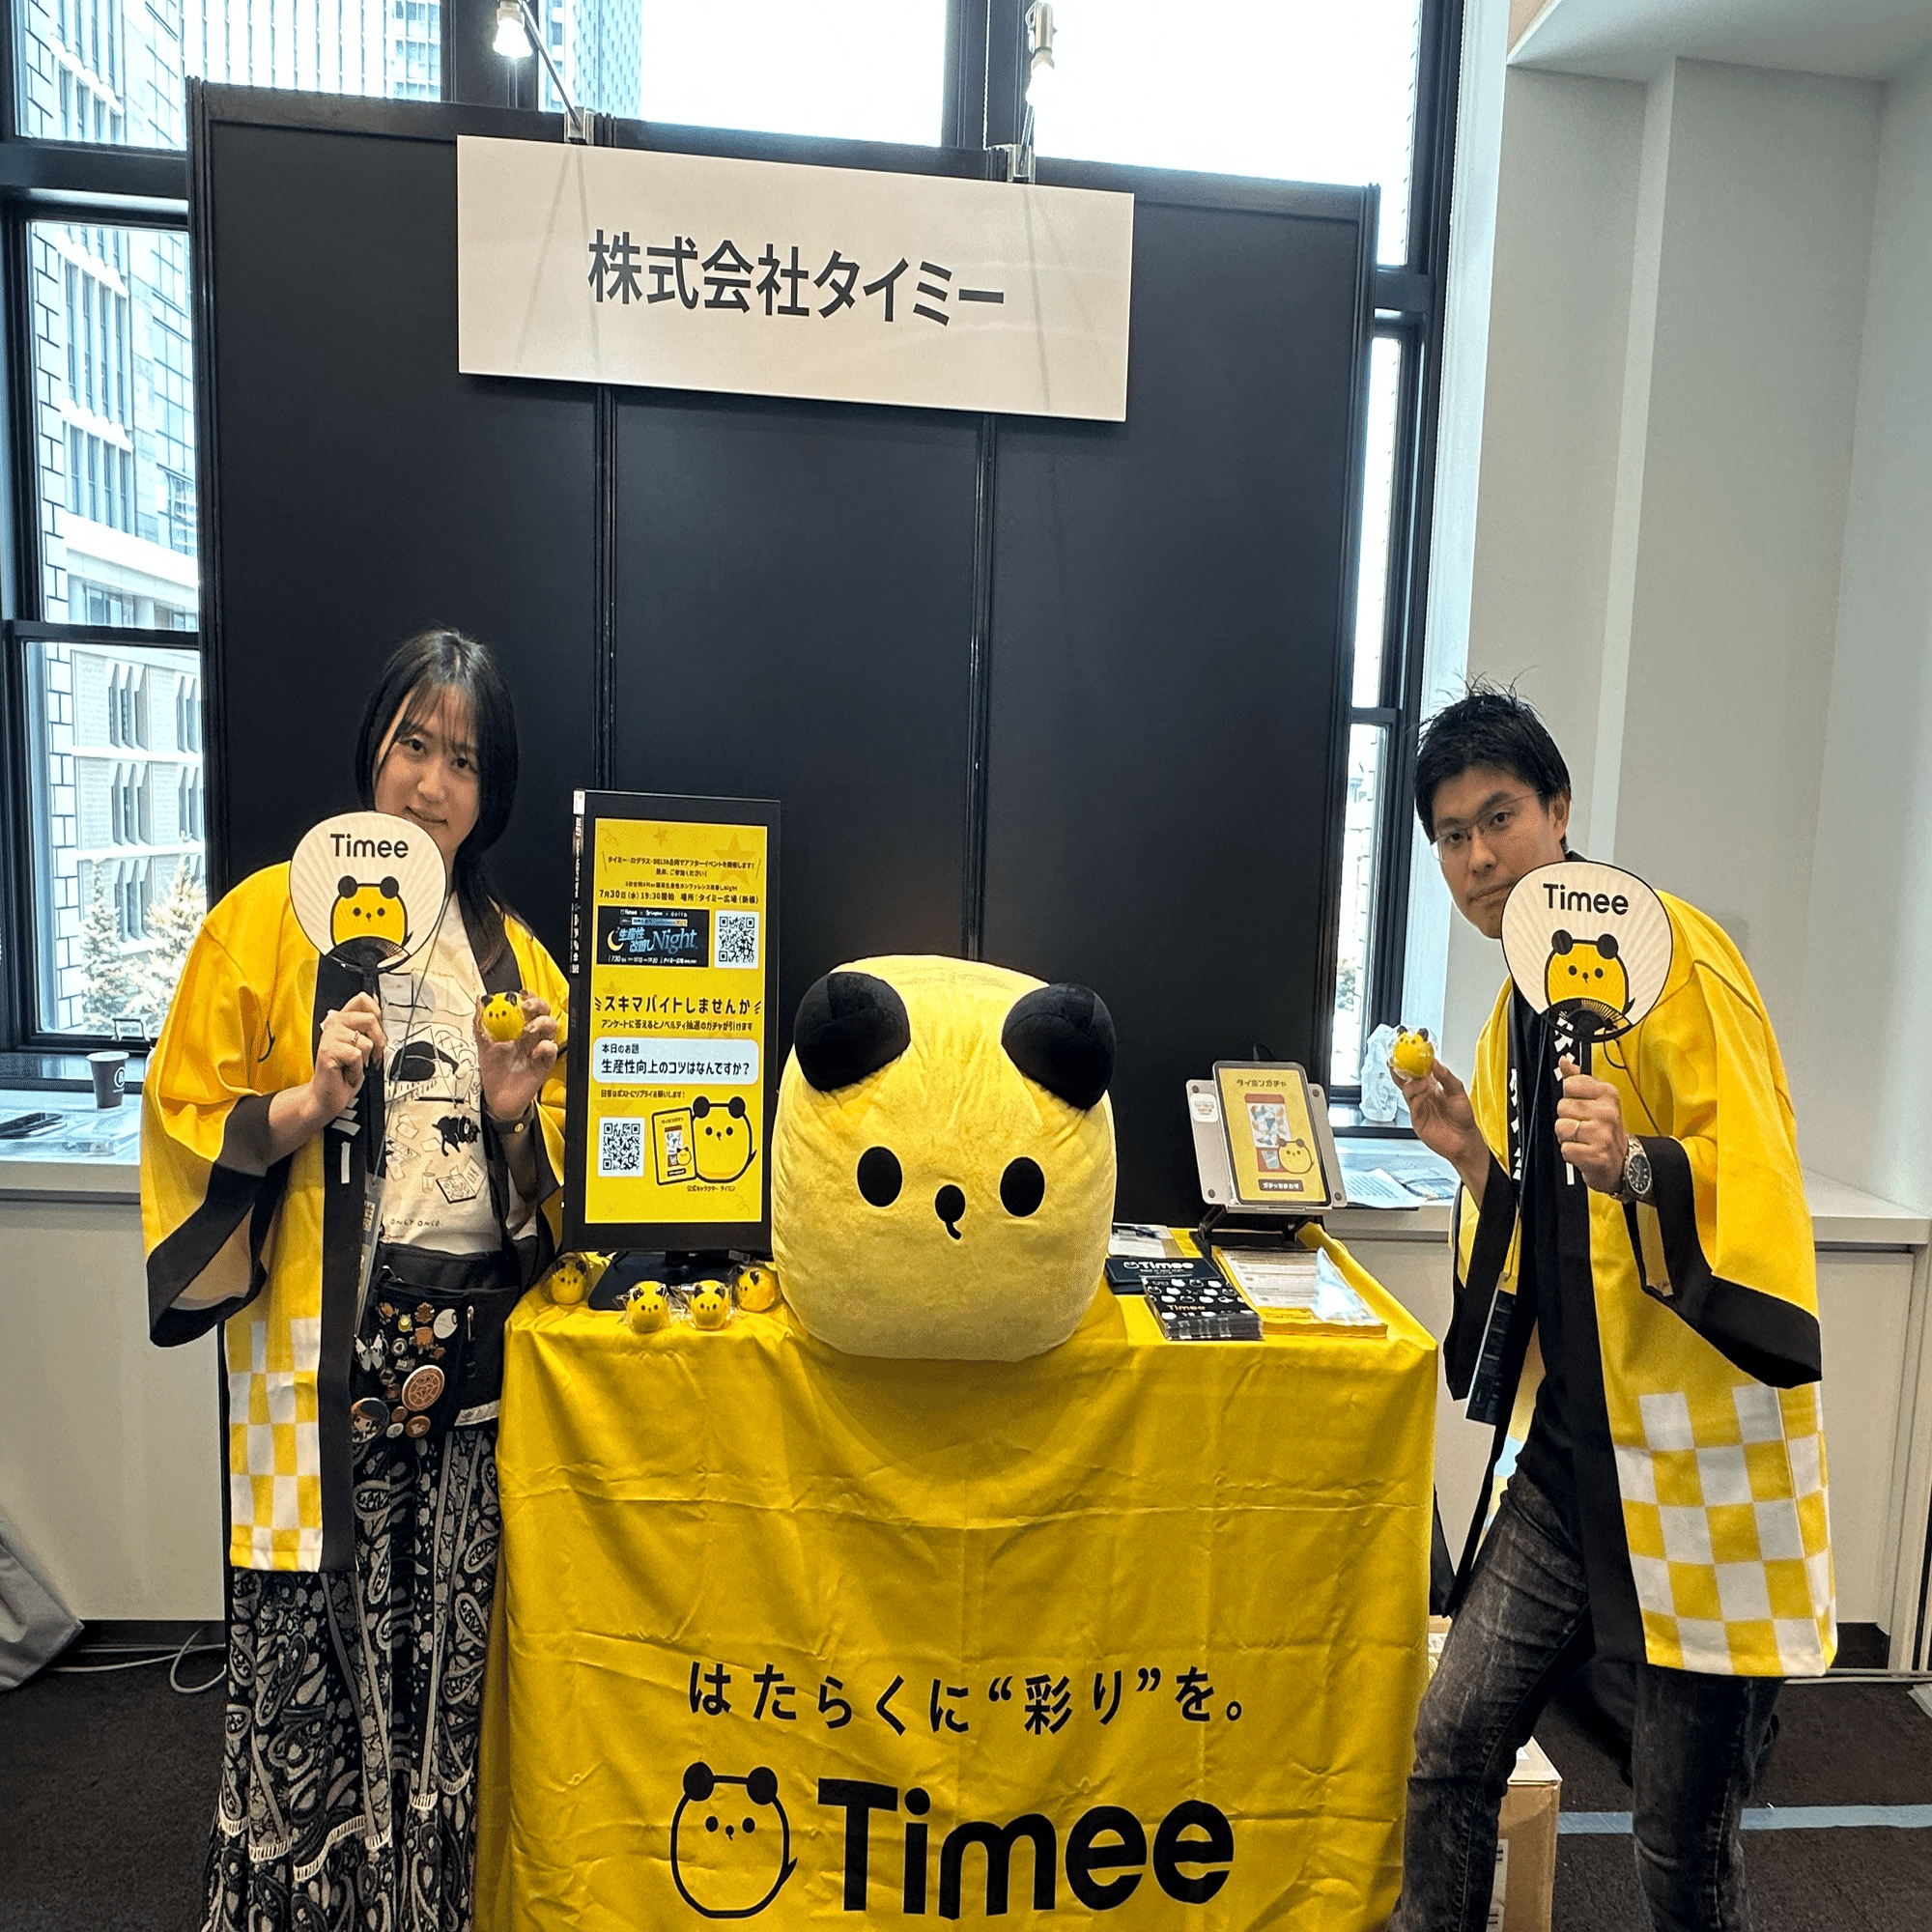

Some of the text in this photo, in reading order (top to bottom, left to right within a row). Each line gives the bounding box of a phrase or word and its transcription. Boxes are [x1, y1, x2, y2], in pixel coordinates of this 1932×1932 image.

[587, 228, 1006, 327] 株式会社タイミー
[330, 833, 409, 858] Timee
[1543, 883, 1630, 915] Timee
[652, 928, 697, 954] Night
[604, 995, 751, 1014] スキマバイトしませんか
[601, 1019, 753, 1031] アンケートに答えるとノベルティ抽選のガチャが引けます
[601, 1043, 639, 1054] 本日のお題
[601, 1059, 750, 1075] 生産性向上のコツはなんですか？
[1138, 1261, 1195, 1269] Timee
[689, 1660, 1244, 1736] はたらくに“彩り”を。
[817, 1777, 1235, 1920] Timee
